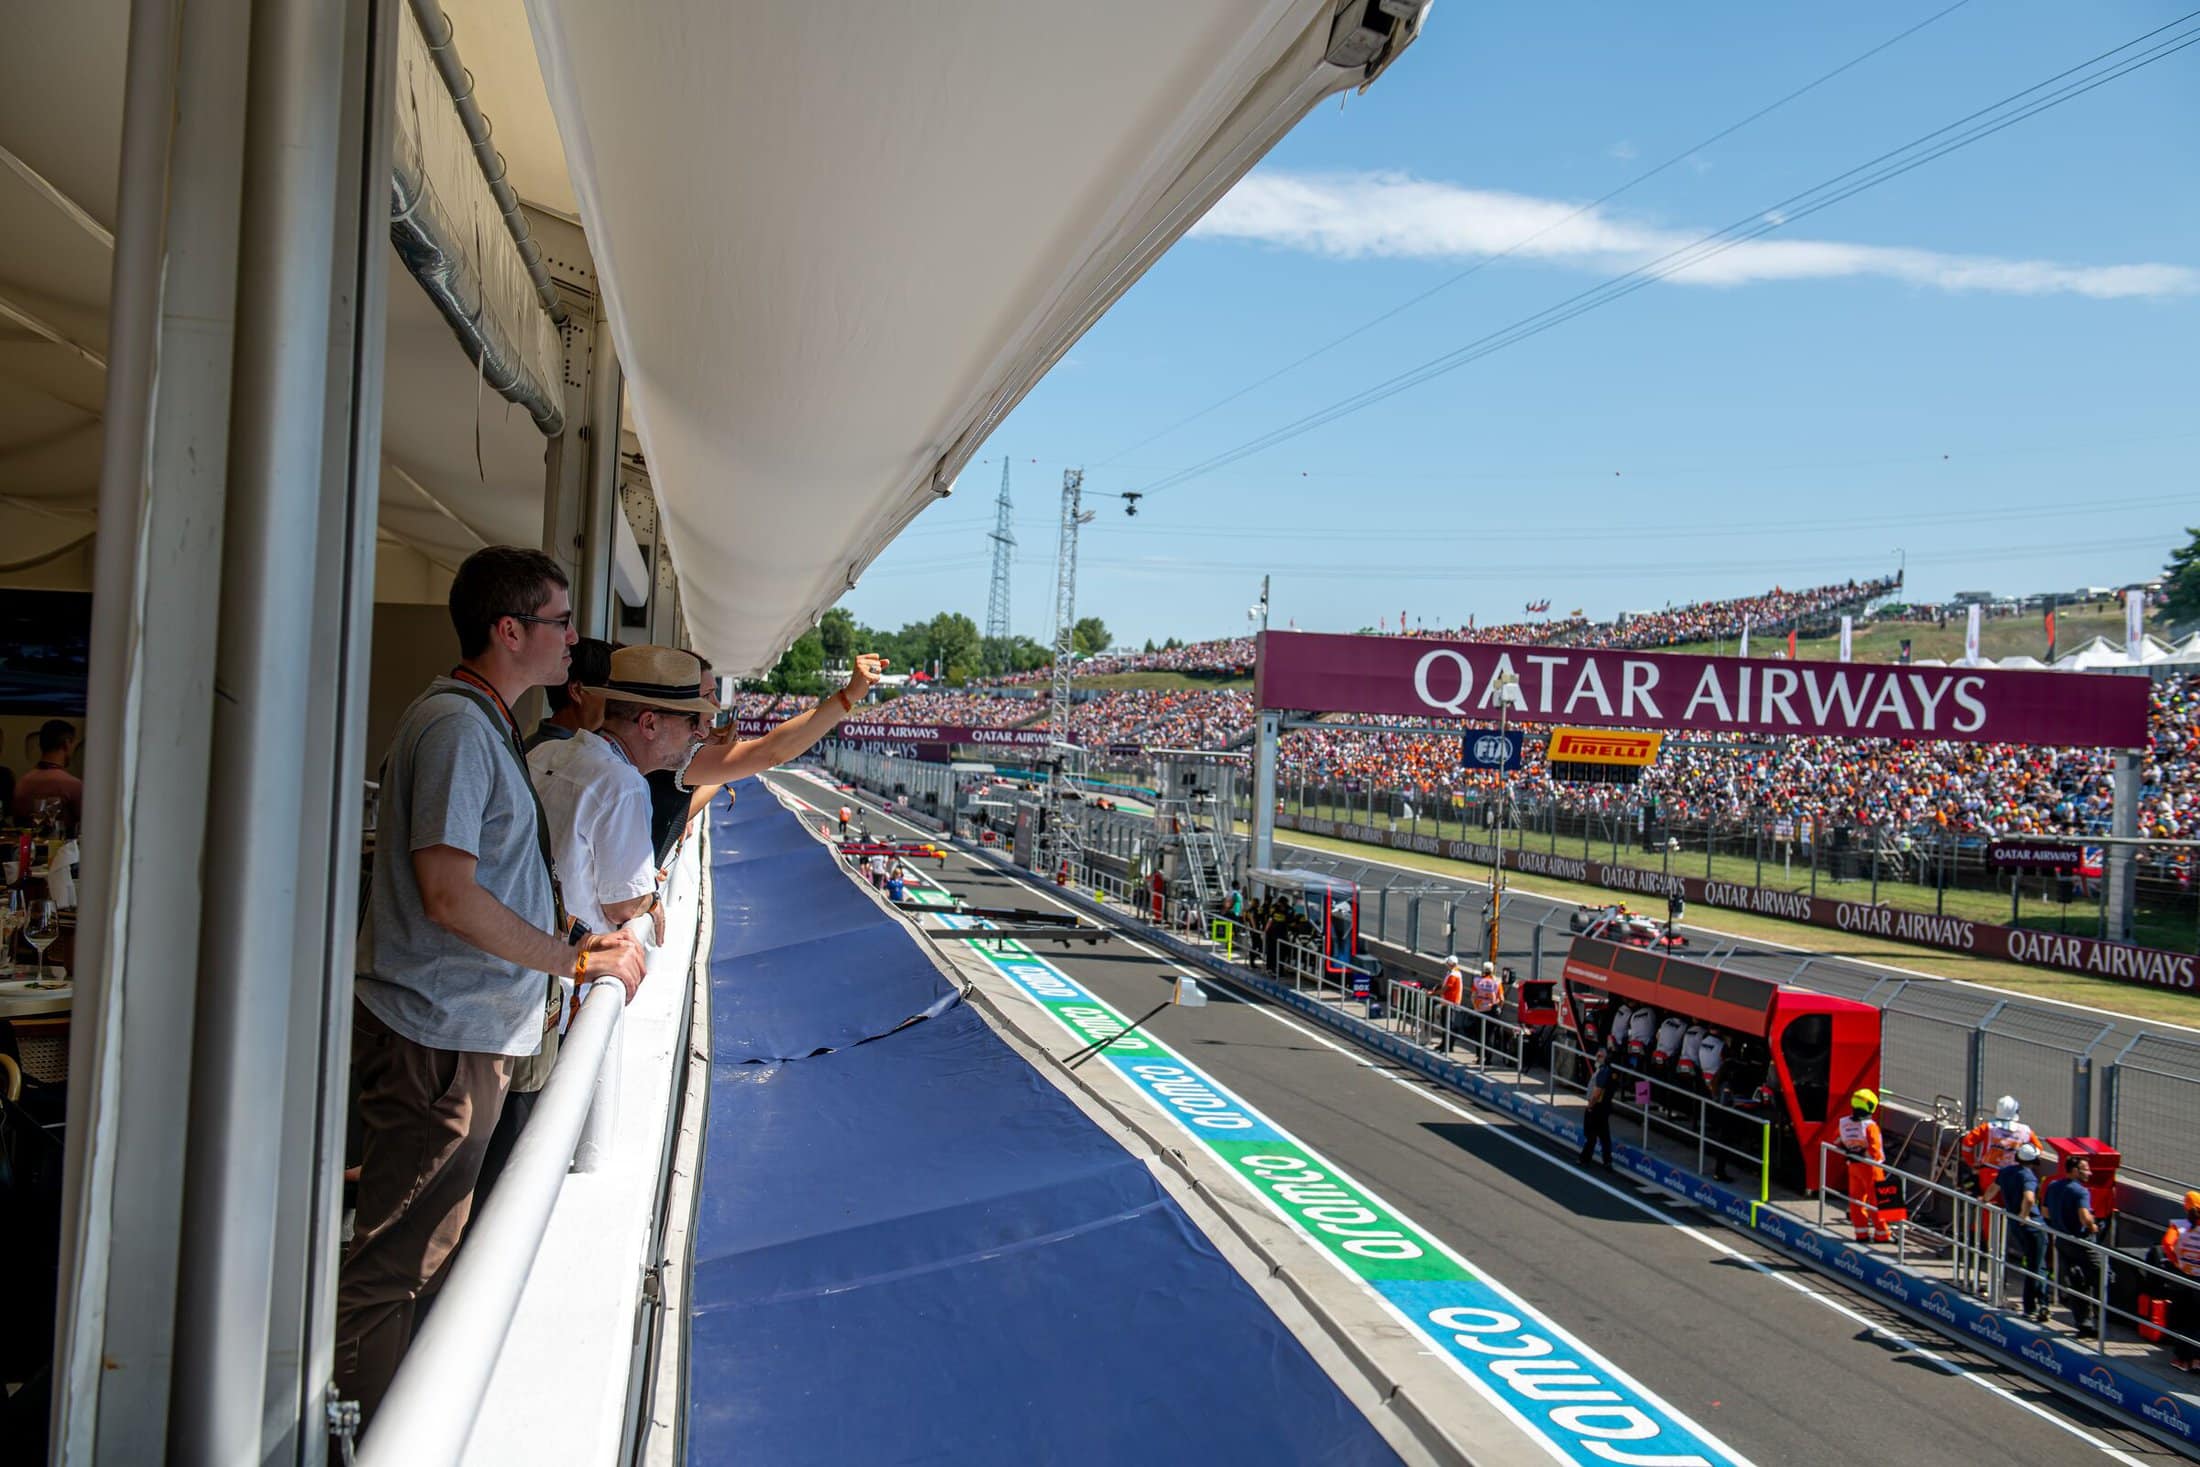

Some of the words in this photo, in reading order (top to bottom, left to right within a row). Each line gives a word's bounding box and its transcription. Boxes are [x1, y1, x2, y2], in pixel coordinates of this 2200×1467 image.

[1414, 649, 1664, 718] QATAR
[1684, 665, 1987, 733] AIRWAYS
[844, 724, 885, 736] QATAR
[887, 726, 939, 738] AIRWAYS
[972, 730, 1012, 741] QATAR
[1558, 735, 1651, 758] PIRELLI
[1448, 841, 1474, 858] QATAR
[1994, 850, 2030, 861] QATAR
[2032, 851, 2078, 862] AIRWAYS
[1518, 852, 1547, 873] QATAR
[1549, 857, 1586, 881] AIRWAYS
[1601, 866, 1636, 889] QATAR
[1639, 870, 1686, 896] AIRWAYS
[1704, 880, 1748, 908] QATAR
[1751, 886, 1812, 921] AIRWAYS
[1836, 903, 1891, 935] QATAR
[1895, 913, 1975, 949] AIRWAYS
[2007, 930, 2082, 968] QATAR
[2087, 943, 2195, 988] AIRWAYS
[1132, 1064, 1254, 1130] aramco
[1239, 1154, 1424, 1260] aramco
[1760, 1221, 1786, 1242] workday
[1795, 1237, 1823, 1259] workday
[1833, 1256, 1865, 1280] workday
[1875, 1277, 1908, 1301] workday
[1921, 1298, 1956, 1323] workday
[1969, 1319, 2007, 1347] workday
[2021, 1344, 2063, 1375] workday
[1428, 1306, 1714, 1467] ramco
[2079, 1372, 2123, 1404] workday
[2141, 1402, 2191, 1437] workday
